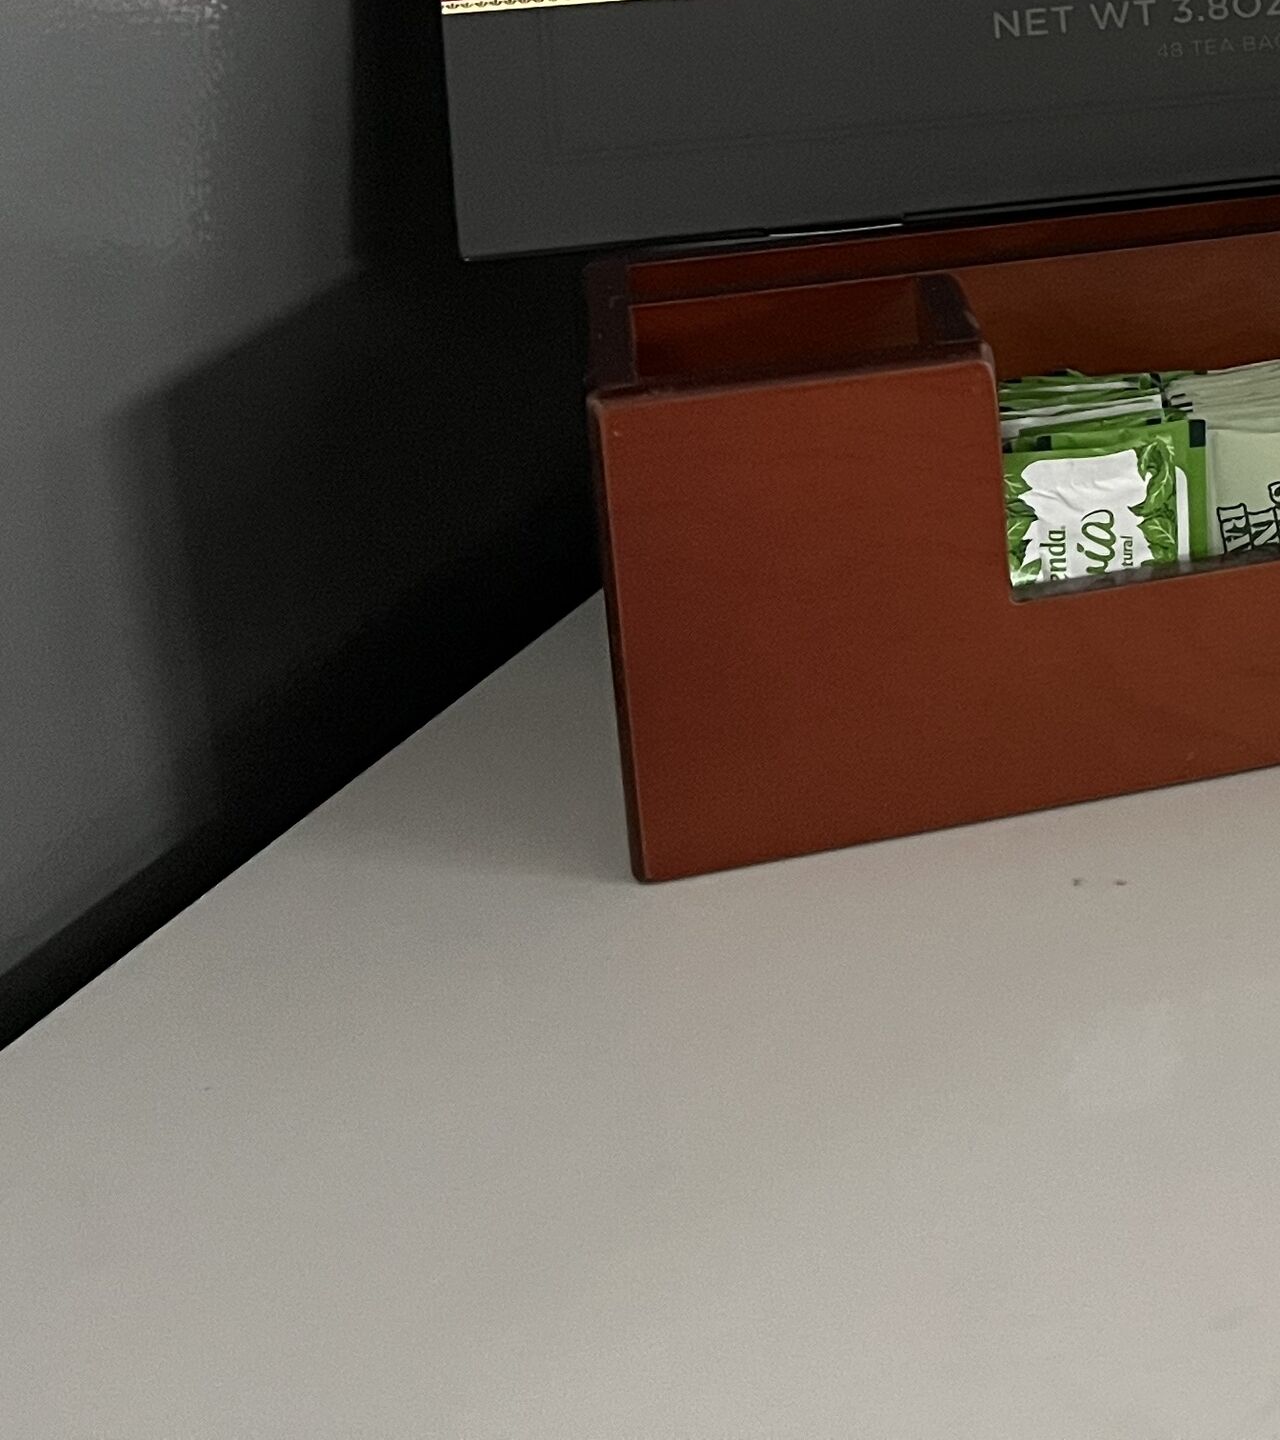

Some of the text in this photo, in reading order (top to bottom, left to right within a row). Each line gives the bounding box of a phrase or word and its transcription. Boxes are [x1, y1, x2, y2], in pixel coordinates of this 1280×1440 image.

[992, 4, 1074, 39] NET
[1193, 36, 1236, 56] TEA
[1216, 502, 1253, 555] RA
